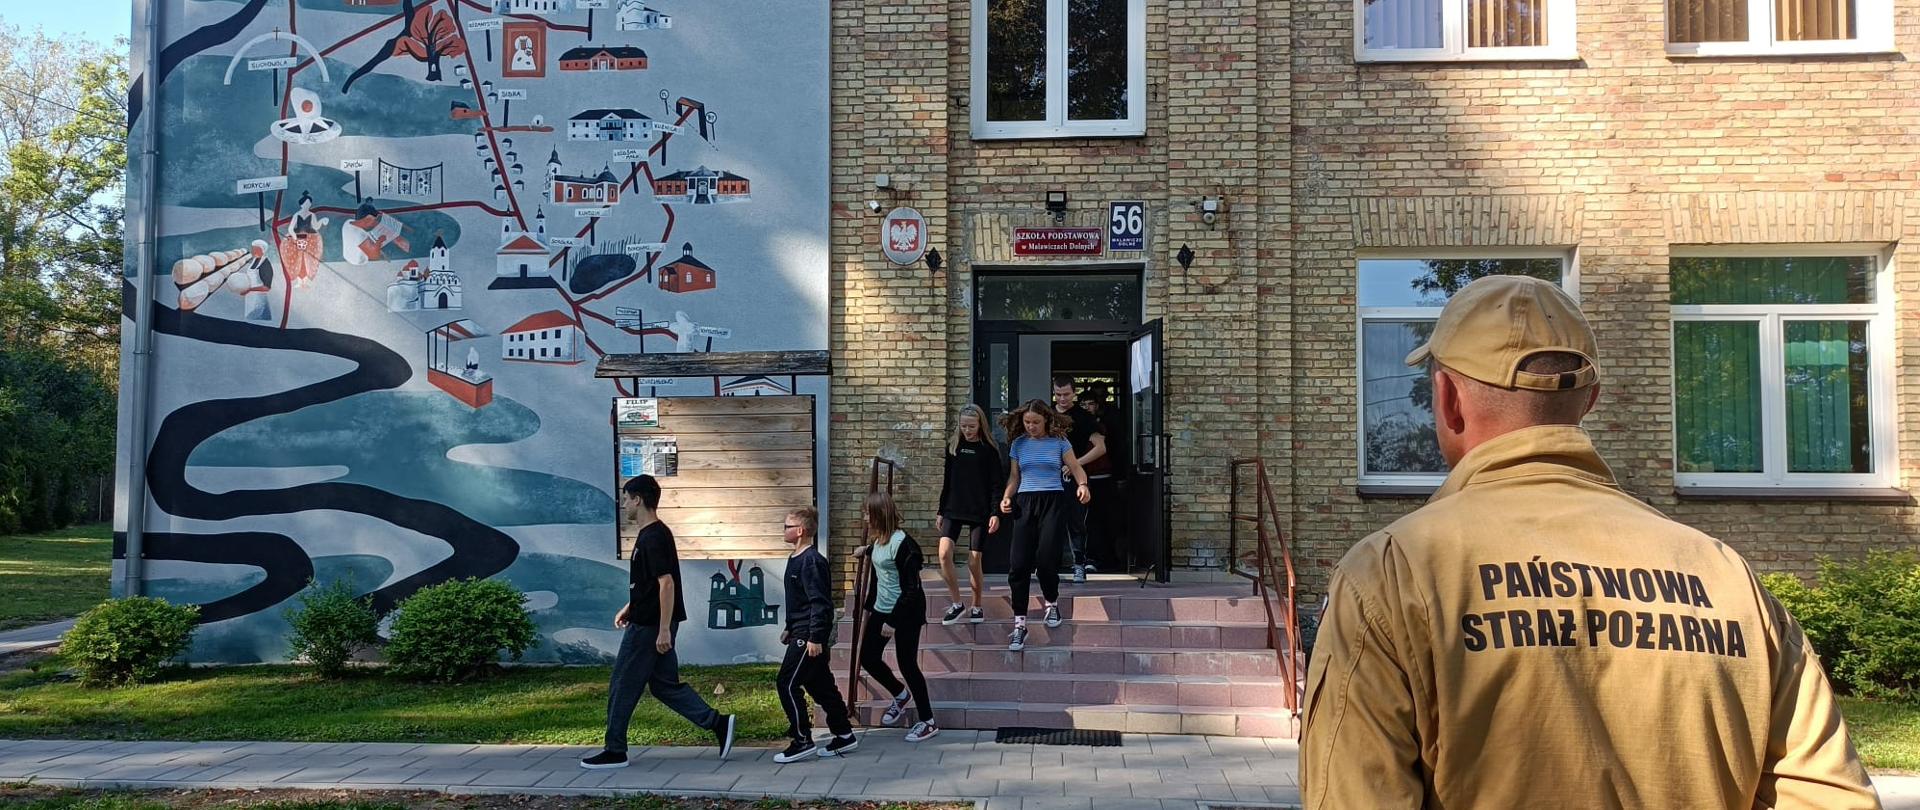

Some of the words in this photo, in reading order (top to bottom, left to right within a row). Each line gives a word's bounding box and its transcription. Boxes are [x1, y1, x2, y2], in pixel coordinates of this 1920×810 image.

[1111, 205, 1143, 235] 56
[1016, 232, 1046, 240] SZKOŁA
[1047, 232, 1100, 240] PODSTAWOWA
[1028, 242, 1068, 250] Malawiczach
[1069, 242, 1095, 251] Dolnych
[1478, 555, 1714, 609] PAŃSTWOWA
[1461, 608, 1577, 652] STRAŻ
[1586, 609, 1747, 658] POŻARNA
